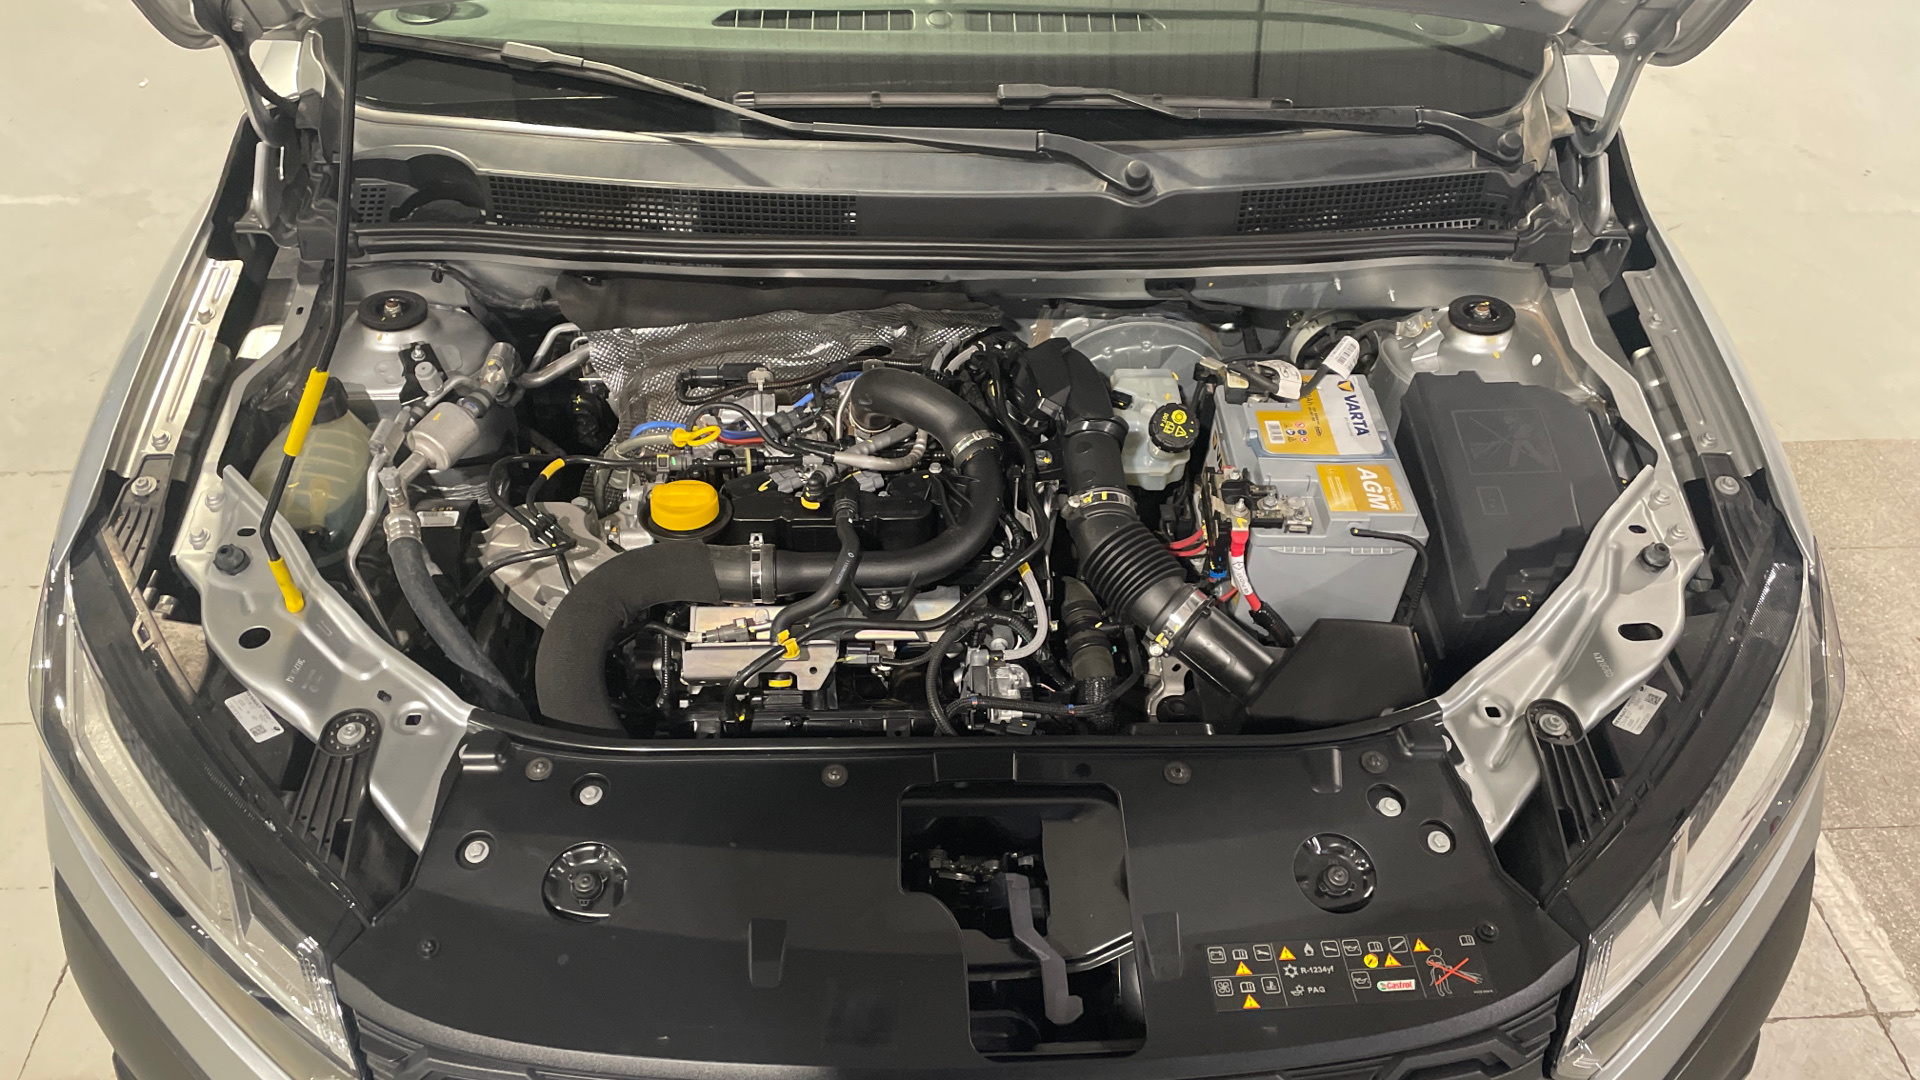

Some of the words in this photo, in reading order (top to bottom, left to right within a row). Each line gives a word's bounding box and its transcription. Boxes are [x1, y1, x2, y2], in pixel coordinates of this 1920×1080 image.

[1344, 394, 1370, 436] VARTA
[1357, 467, 1390, 511] AGM
[1300, 965, 1334, 975] R-1234yf
[1307, 985, 1326, 994] PAG
[1386, 981, 1413, 990] Castrol
